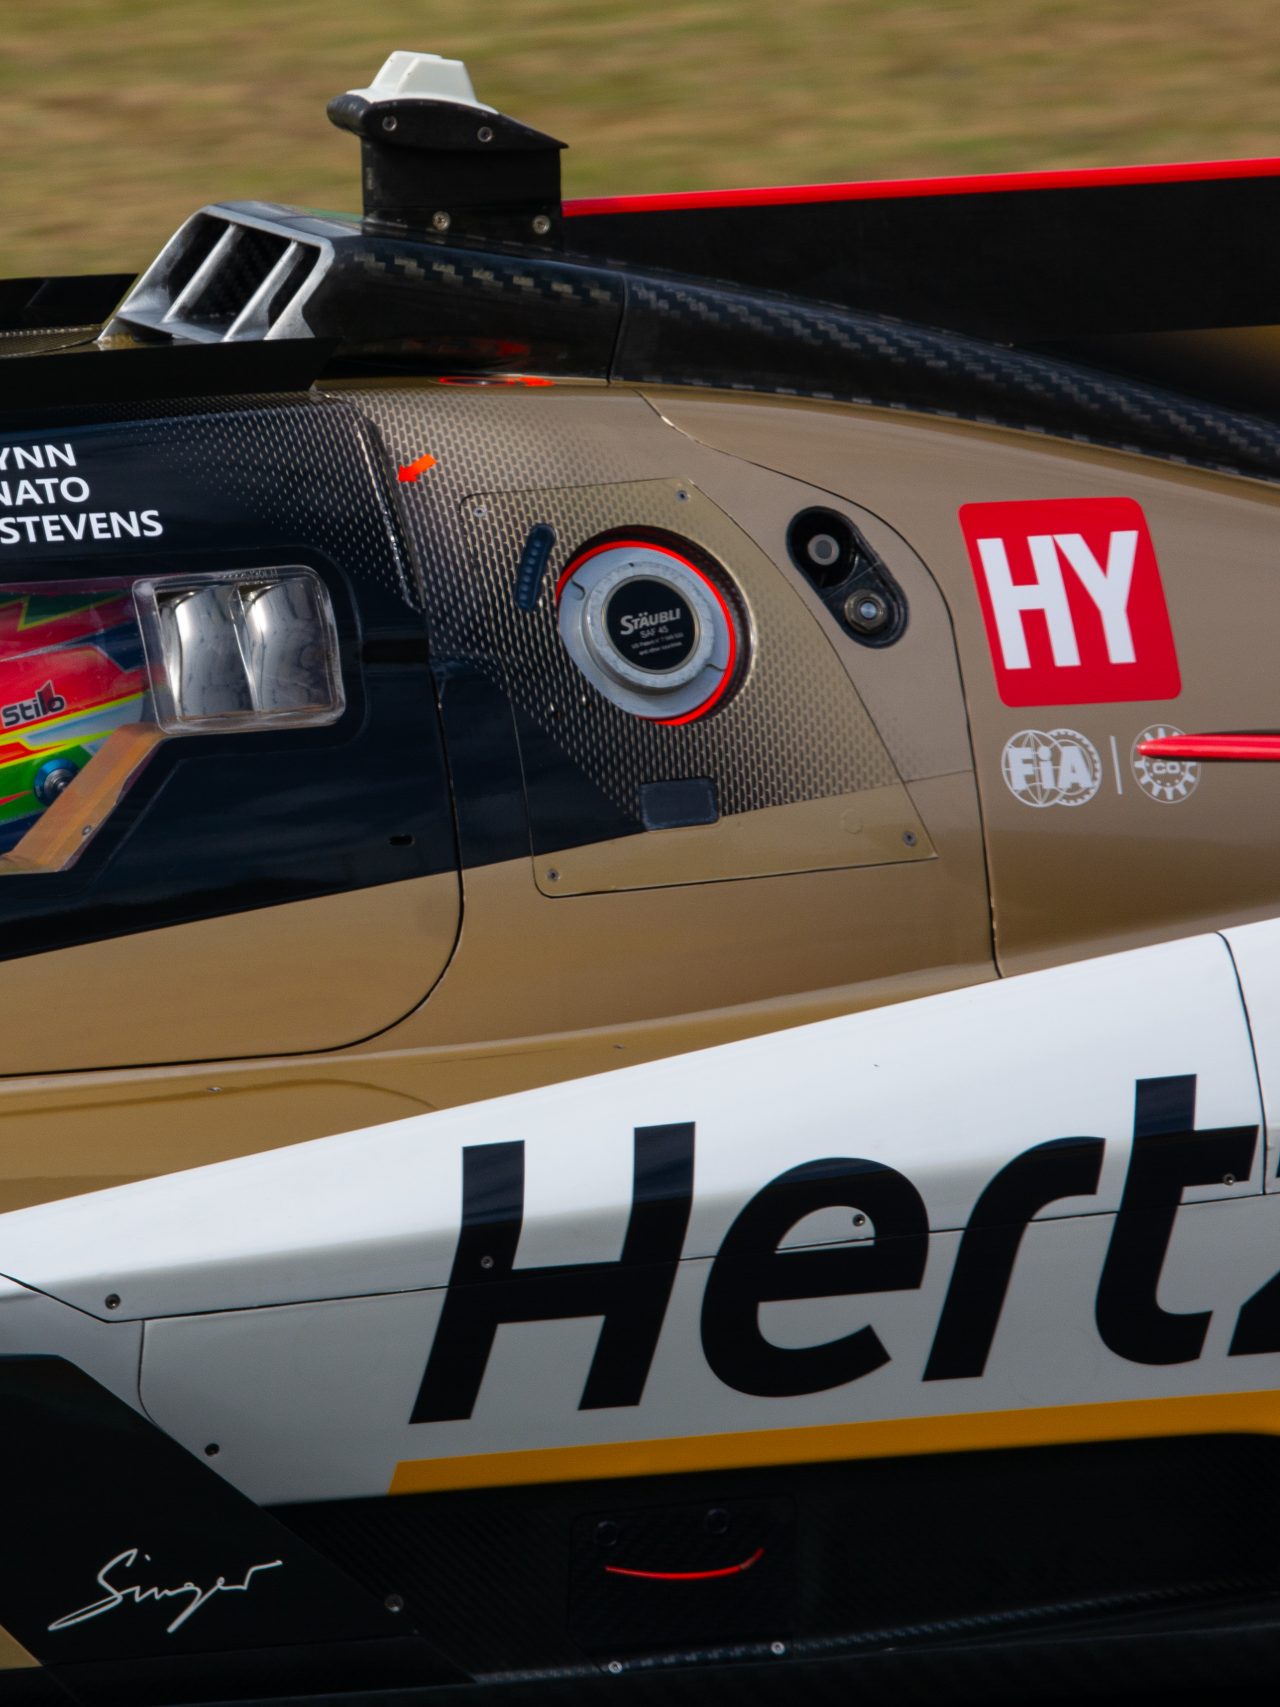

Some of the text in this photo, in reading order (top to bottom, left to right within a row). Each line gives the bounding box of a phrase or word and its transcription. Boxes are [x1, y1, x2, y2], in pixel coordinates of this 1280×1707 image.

[976, 530, 1139, 670] HY
[408, 1073, 1280, 1425] Hert
[48, 1548, 284, 1633] Singer
